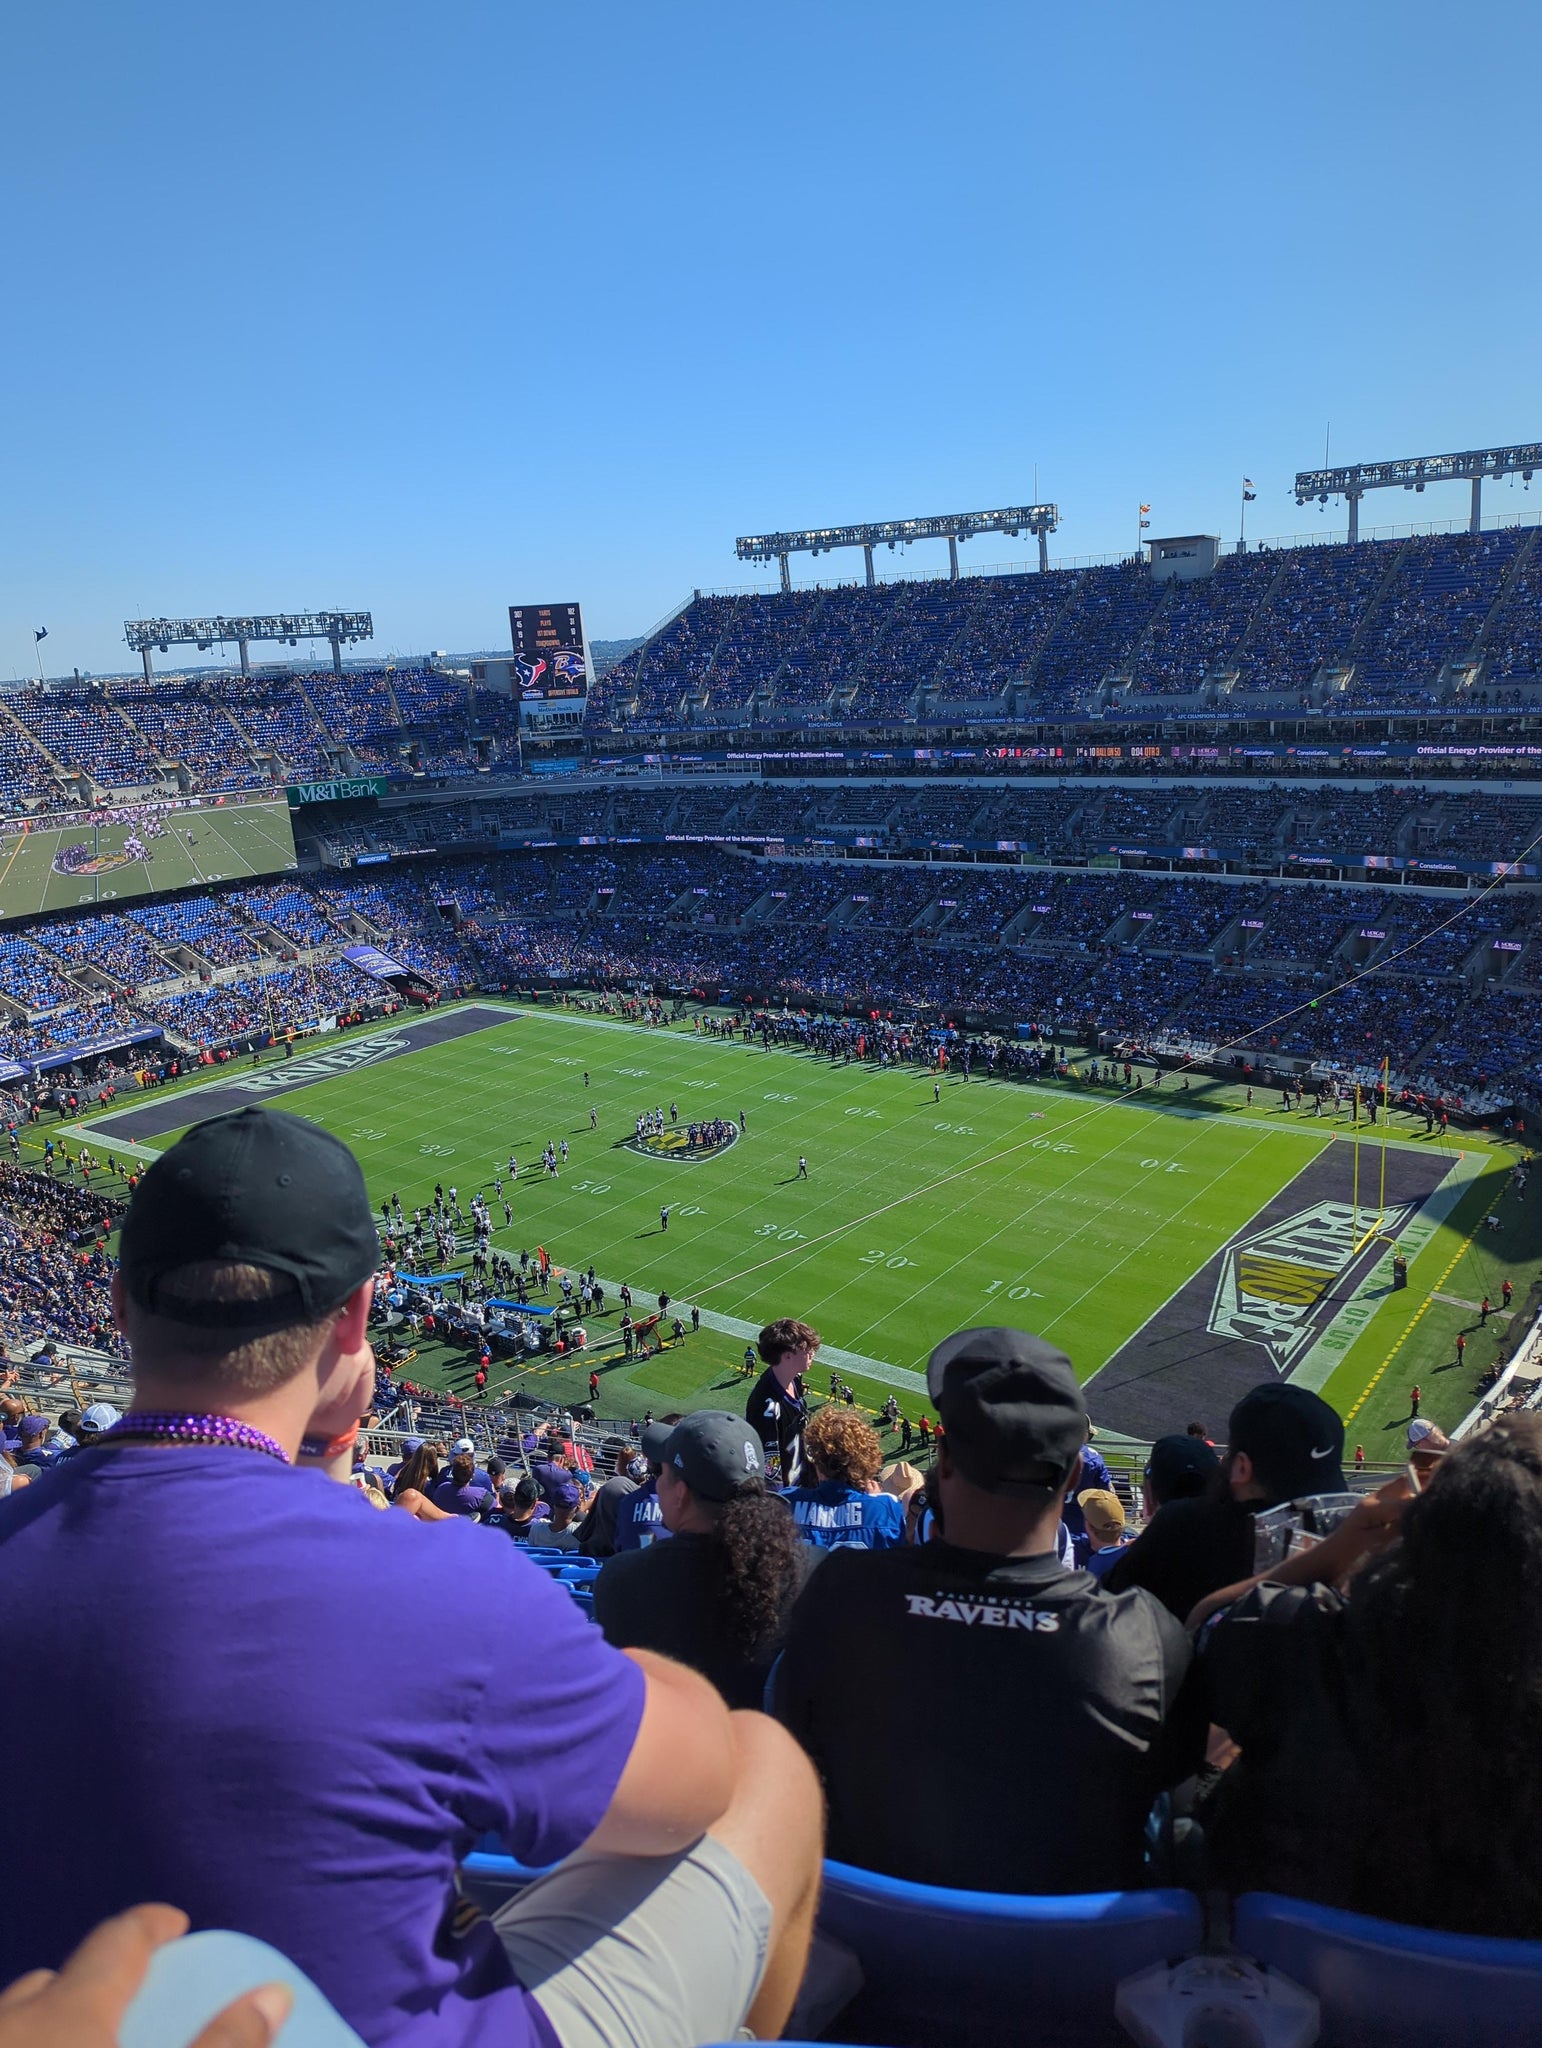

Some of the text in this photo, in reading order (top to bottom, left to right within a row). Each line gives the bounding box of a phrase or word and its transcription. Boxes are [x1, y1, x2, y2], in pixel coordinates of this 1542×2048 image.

[1008, 748, 1014, 757] 34
[1416, 746, 1446, 754] Official
[1448, 746, 1477, 756] Energy
[1479, 746, 1515, 754] Provider
[1516, 746, 1526, 754] of
[298, 780, 380, 803] M&T Bank
[1419, 862, 1456, 870] Constellation
[236, 1038, 406, 1092] RAVENS
[571, 1180, 611, 1195] 50
[754, 1223, 800, 1242] 30
[858, 1250, 909, 1269] 20
[1212, 1202, 1407, 1358] BALTIMORE
[981, 1280, 1032, 1300] 10
[1322, 1329, 1354, 1350] US
[904, 1594, 1060, 1632] RAVENS
